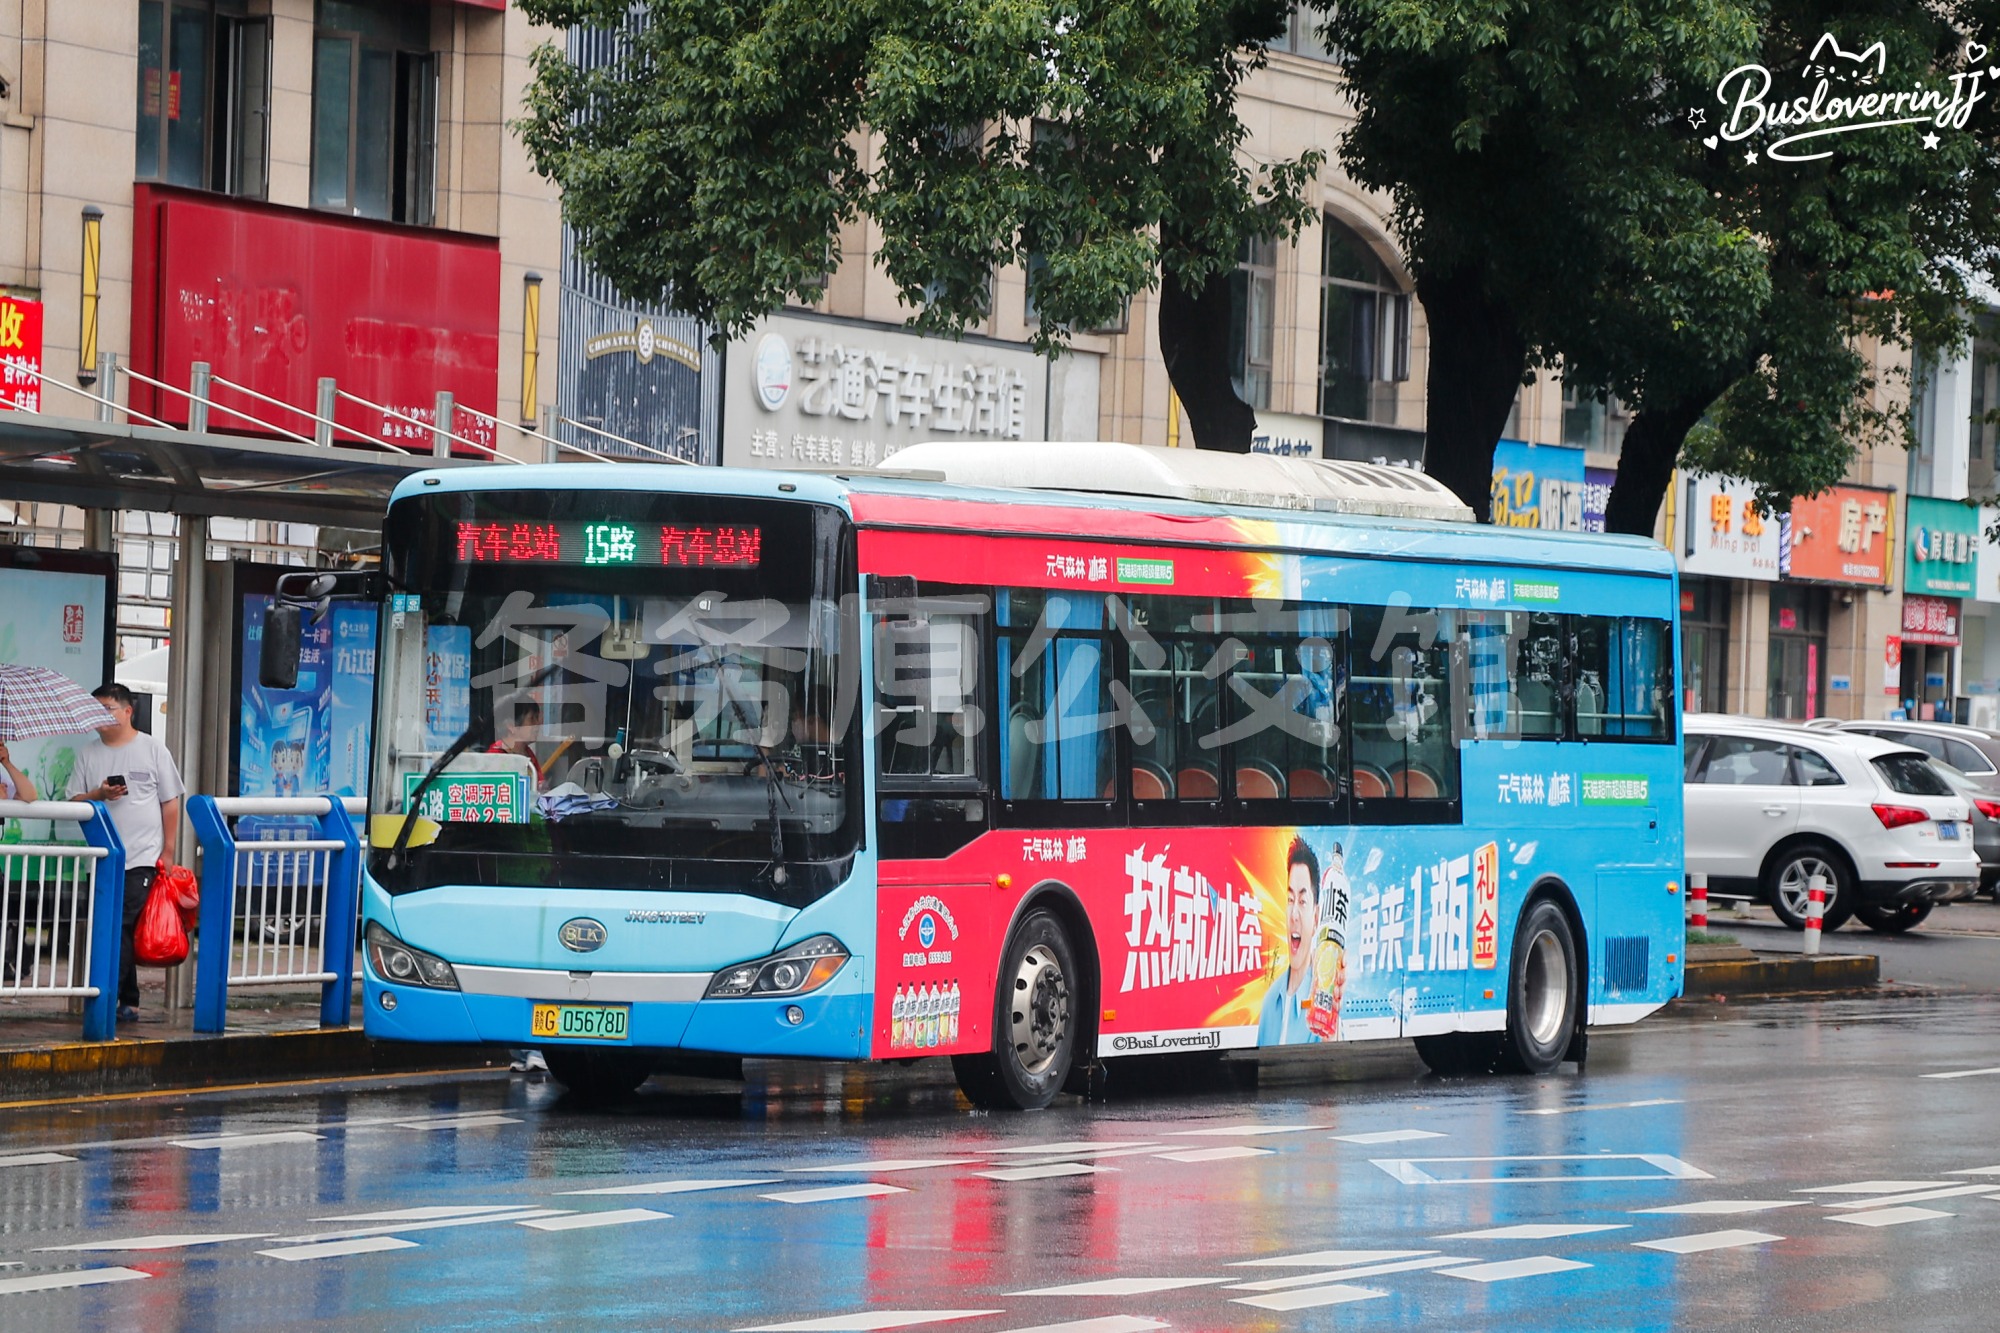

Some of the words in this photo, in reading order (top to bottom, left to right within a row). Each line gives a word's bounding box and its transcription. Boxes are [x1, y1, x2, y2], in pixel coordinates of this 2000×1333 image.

[588, 335, 636, 353] CHINATEA
[655, 338, 700, 366] CHINATEA
[797, 337, 1027, 439] 艺通汽车生活馆
[791, 433, 843, 464] 汽车美容
[851, 440, 876, 467] 维修
[1838, 498, 1887, 554] 房产
[456, 523, 560, 561] 汽车总站
[585, 525, 636, 564] 15路
[660, 526, 762, 566] 汽车总站
[1046, 554, 1086, 580] 元气森林
[1455, 577, 1488, 600] 元气森林
[426, 651, 442, 724] 小心开门
[410, 788, 444, 821] 5路
[448, 783, 511, 805] 空调开启
[1498, 773, 1545, 804] 元气森林
[1022, 837, 1063, 862] 元气森林
[1120, 842, 1263, 993] 热就冰茶
[1358, 854, 1469, 973] 再来1瓶
[1475, 852, 1495, 960] 礼金
[565, 928, 599, 942] BLK
